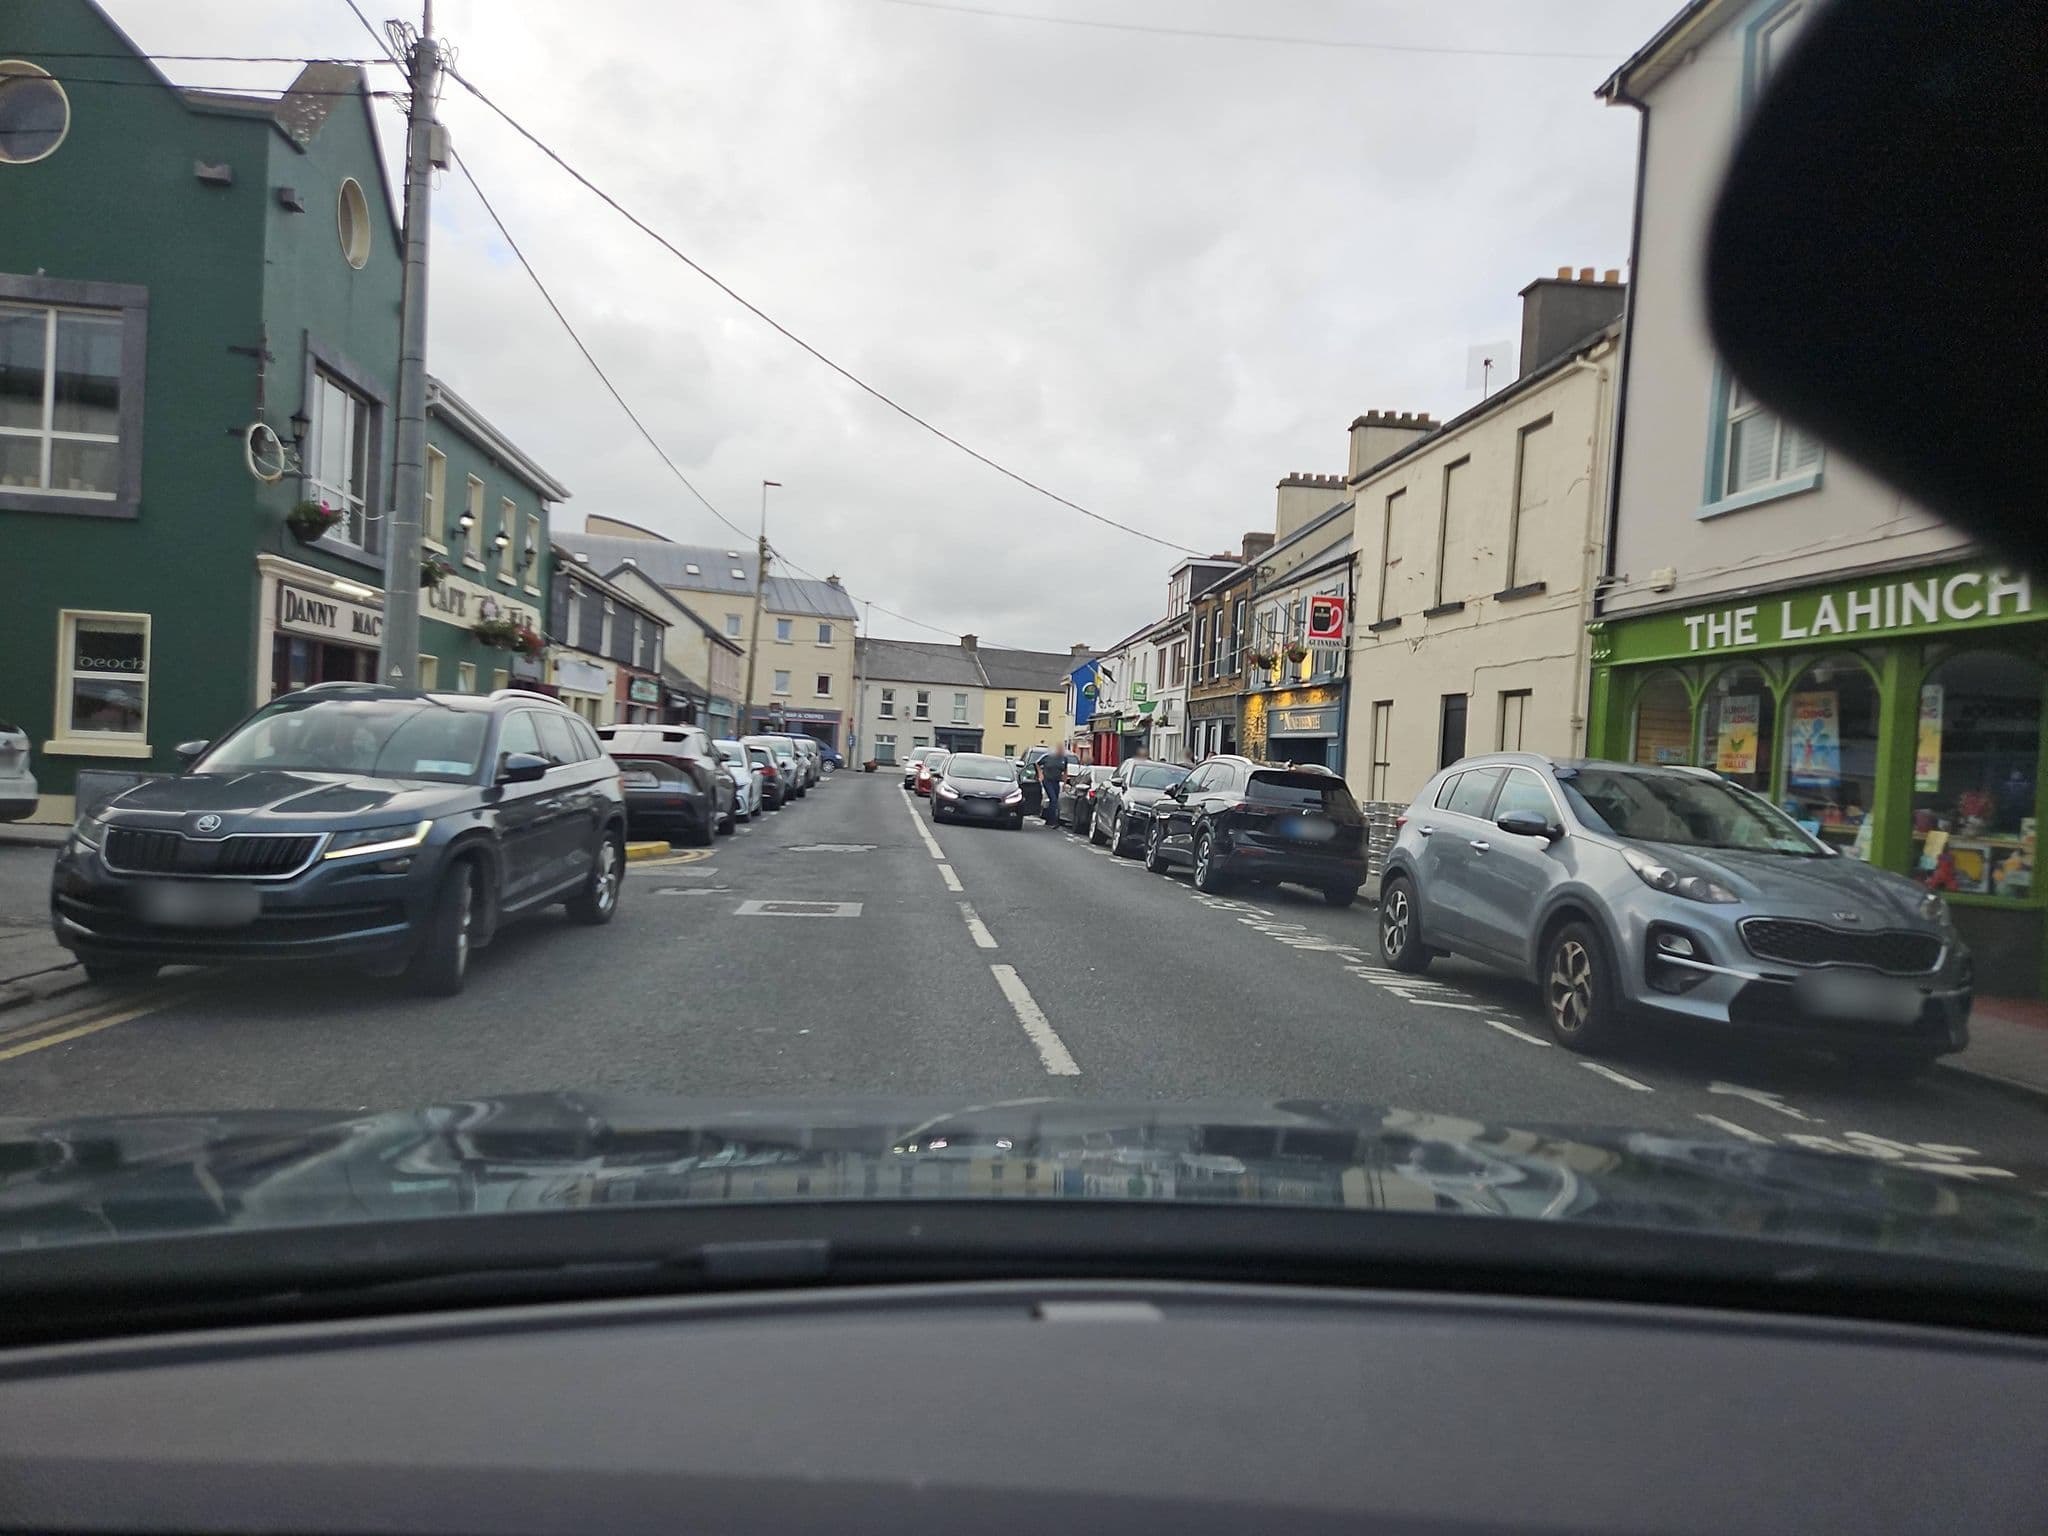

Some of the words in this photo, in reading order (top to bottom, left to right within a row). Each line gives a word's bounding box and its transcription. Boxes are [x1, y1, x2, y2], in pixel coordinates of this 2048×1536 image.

[285, 590, 338, 628] DANNY
[1683, 606, 1759, 651] THE
[1781, 570, 2032, 640] LAHINCH
[1308, 639, 1341, 647] GUINNESS
